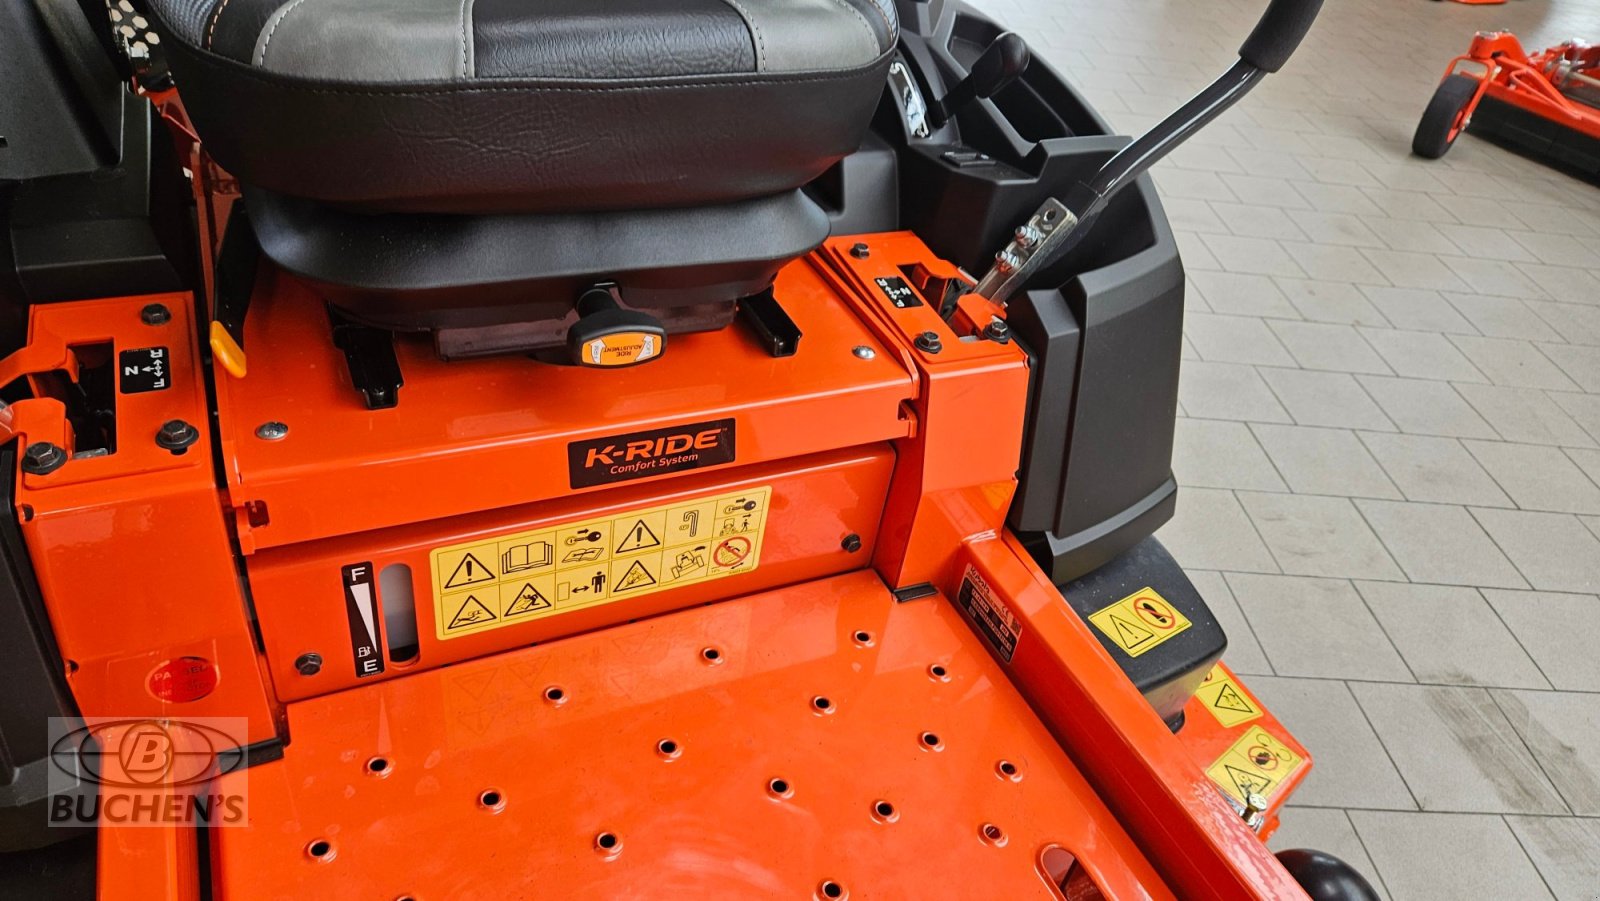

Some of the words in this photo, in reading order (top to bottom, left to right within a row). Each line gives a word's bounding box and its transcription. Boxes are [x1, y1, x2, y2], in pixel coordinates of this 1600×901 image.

[150, 348, 163, 358] R
[604, 344, 643, 353] ADJUSTMENT
[153, 378, 165, 388] F
[585, 428, 722, 468] K-RIDE
[610, 459, 656, 475] Comfort
[658, 453, 699, 468] System
[351, 567, 366, 581] F
[363, 659, 378, 673] E
